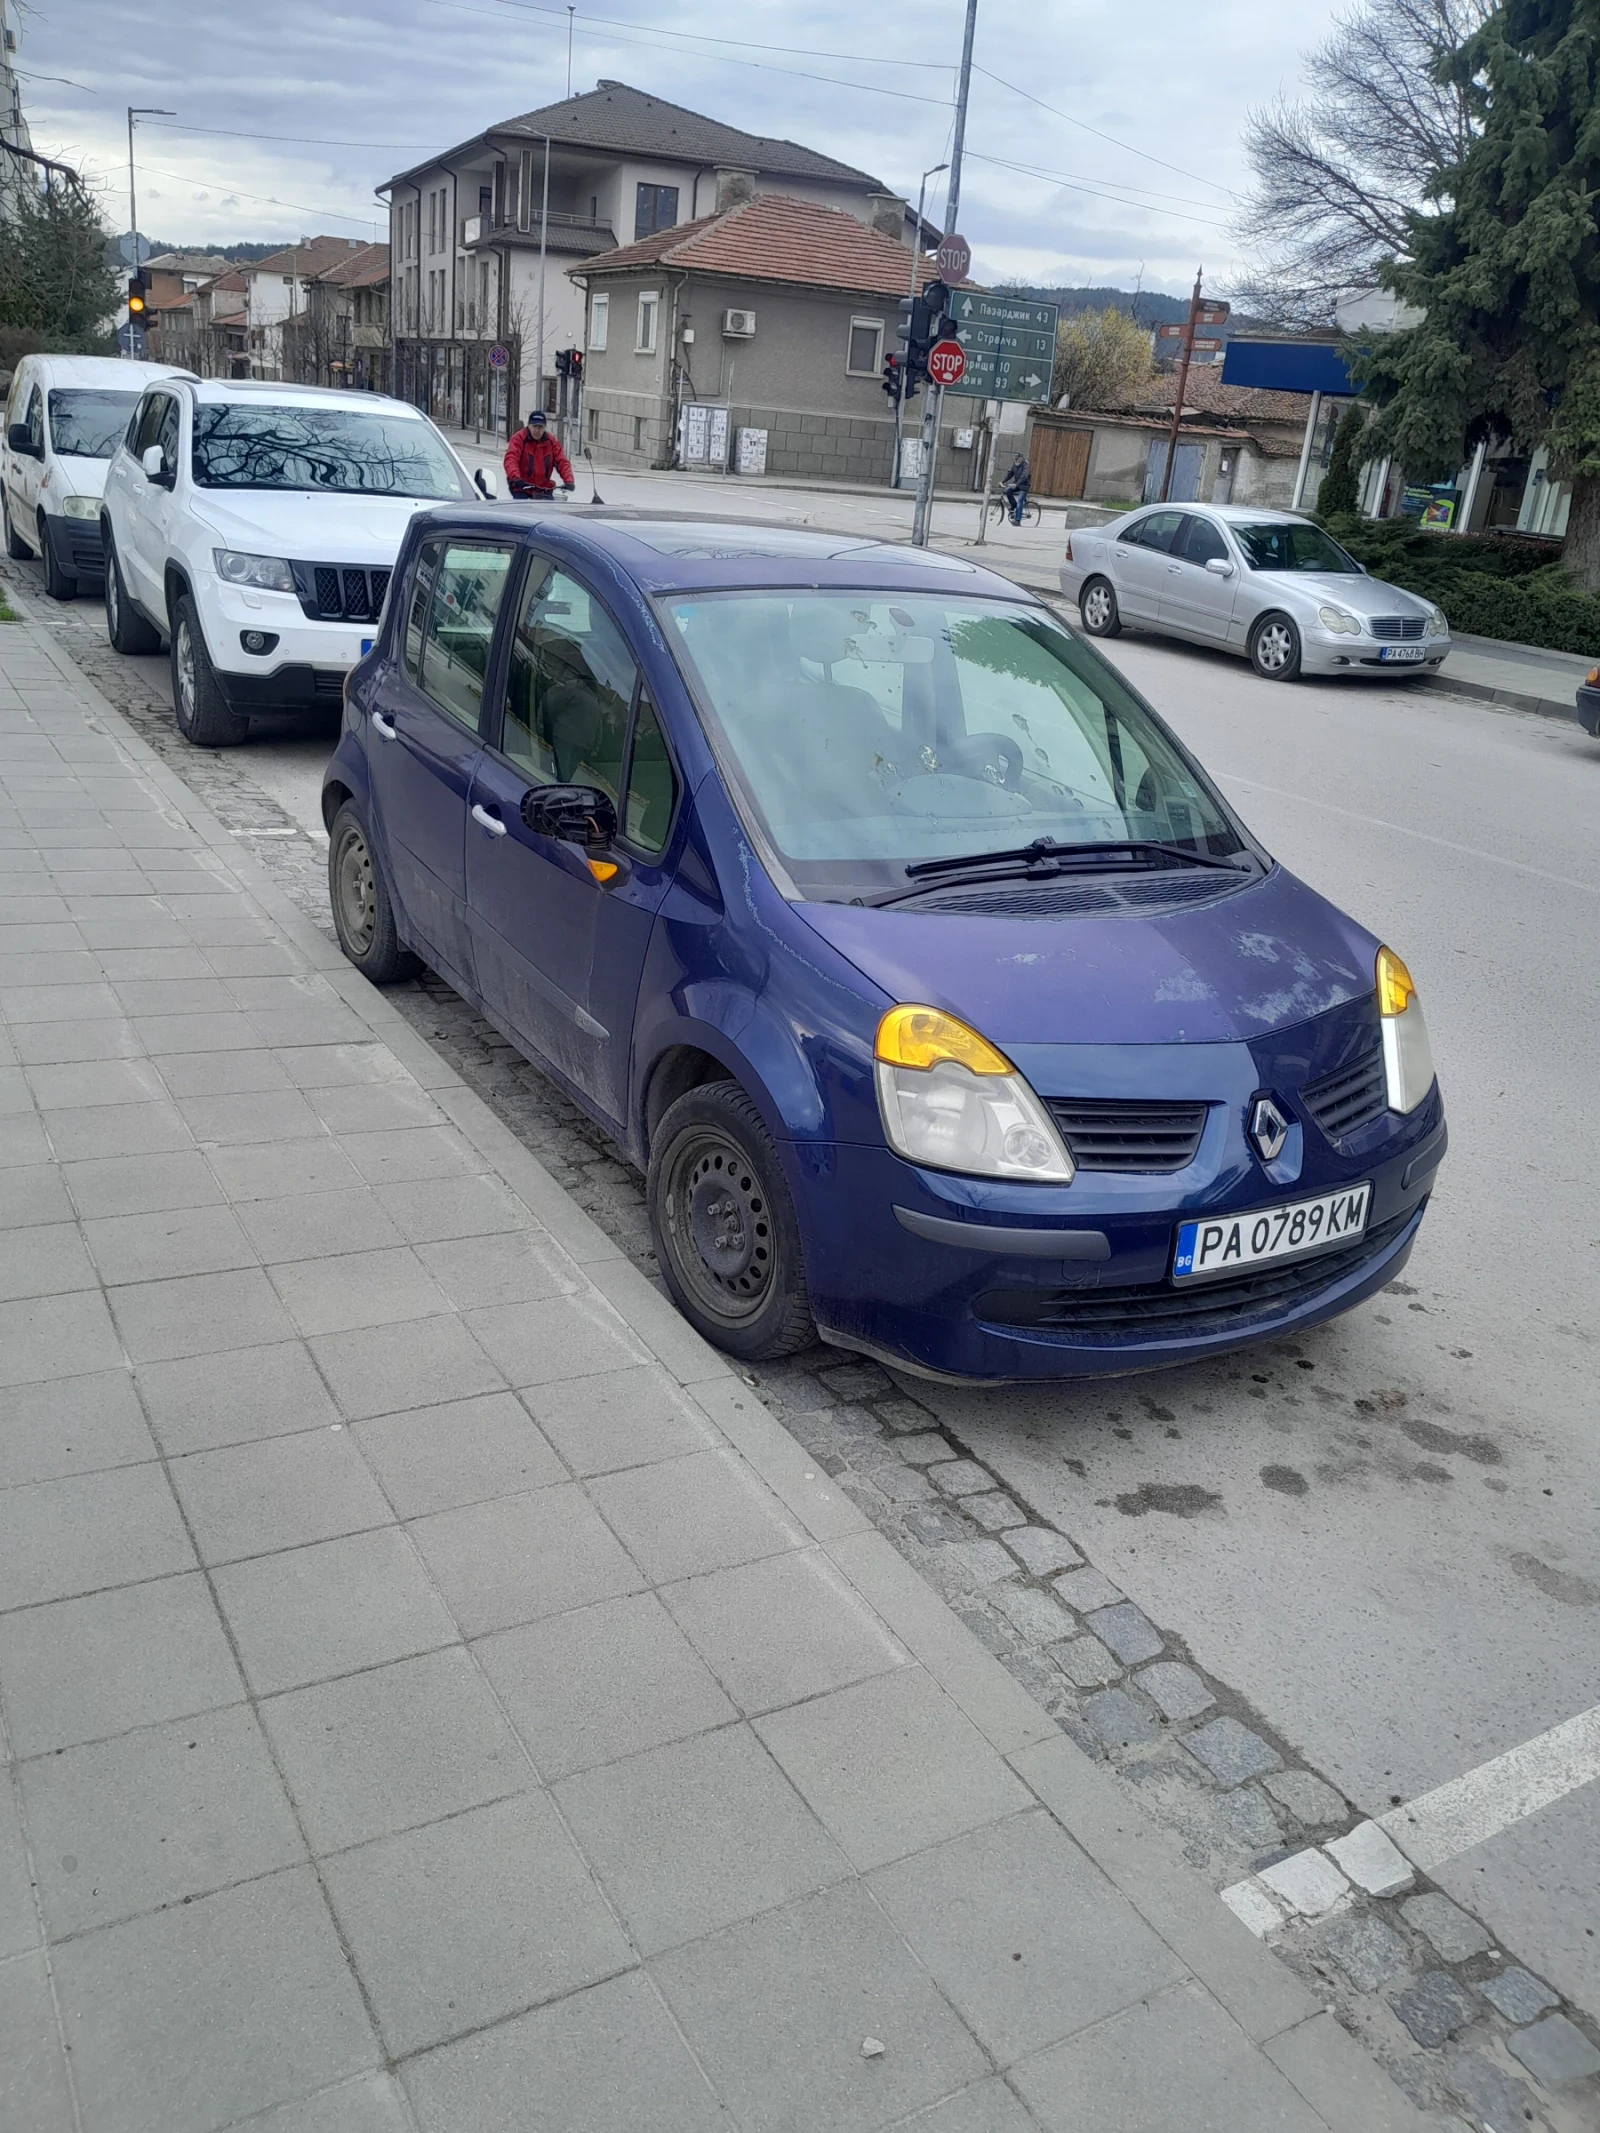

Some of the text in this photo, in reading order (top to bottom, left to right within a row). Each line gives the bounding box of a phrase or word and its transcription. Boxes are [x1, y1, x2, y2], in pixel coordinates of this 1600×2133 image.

[939, 248, 968, 271] STOP
[979, 303, 1049, 324] Пазарджик 43
[977, 331, 1046, 351] Стрелча 13
[932, 353, 963, 371] STOP
[1000, 361, 1011, 373] 10
[995, 376, 1008, 389] 93
[1177, 1256, 1192, 1268] BG
